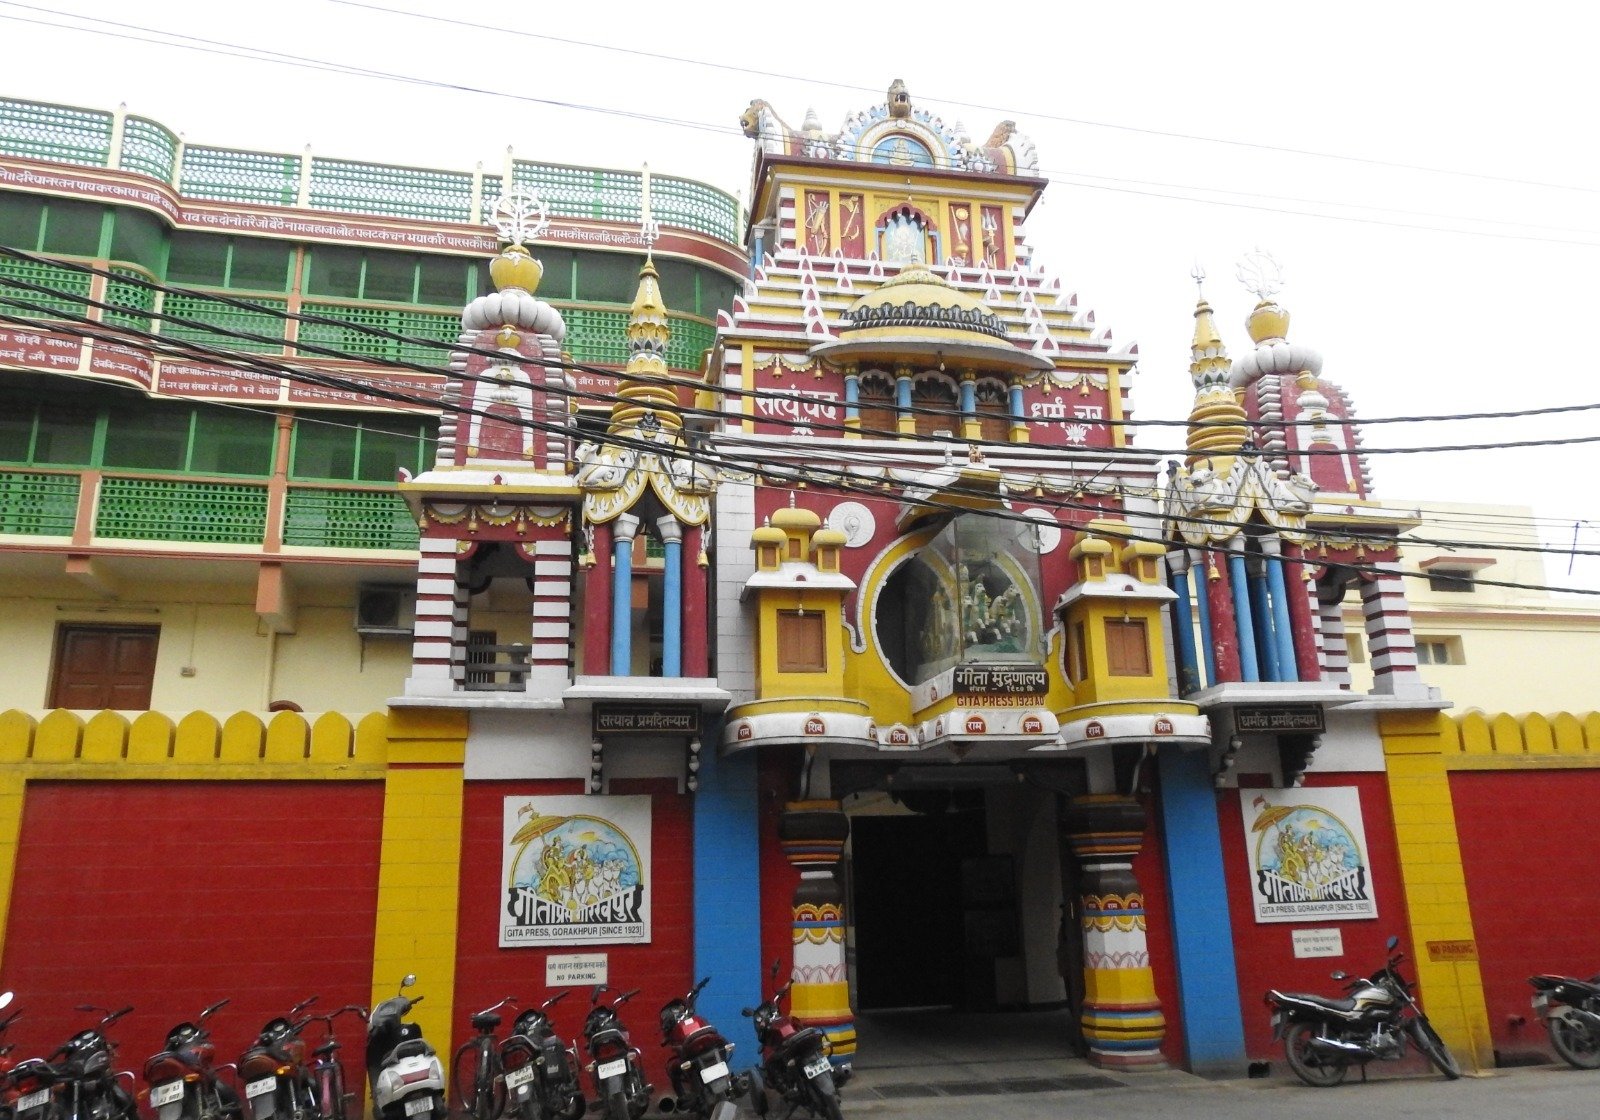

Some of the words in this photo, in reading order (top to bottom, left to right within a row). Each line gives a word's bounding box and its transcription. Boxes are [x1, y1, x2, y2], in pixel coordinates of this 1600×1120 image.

[956, 667, 989, 685] गीता
[992, 672, 1047, 687] मुद्रणालय
[957, 695, 980, 706] GITA
[982, 695, 1014, 706] PRESS
[1016, 695, 1034, 706] 1923
[808, 720, 825, 734] शिव
[967, 721, 983, 731] राम
[1025, 721, 1041, 733] कृष्ण
[1088, 726, 1101, 736] राम
[1157, 719, 1171, 731] शिव
[893, 730, 906, 743] शिव
[1262, 906, 1275, 914] GITA
[1298, 904, 1335, 913] GORAKHPUR
[507, 927, 523, 937] GITA
[525, 926, 550, 938] PRESS,
[552, 926, 598, 937] GORAKHPUR
[600, 925, 623, 936] [SINCE
[625, 925, 642, 935] 1923]
